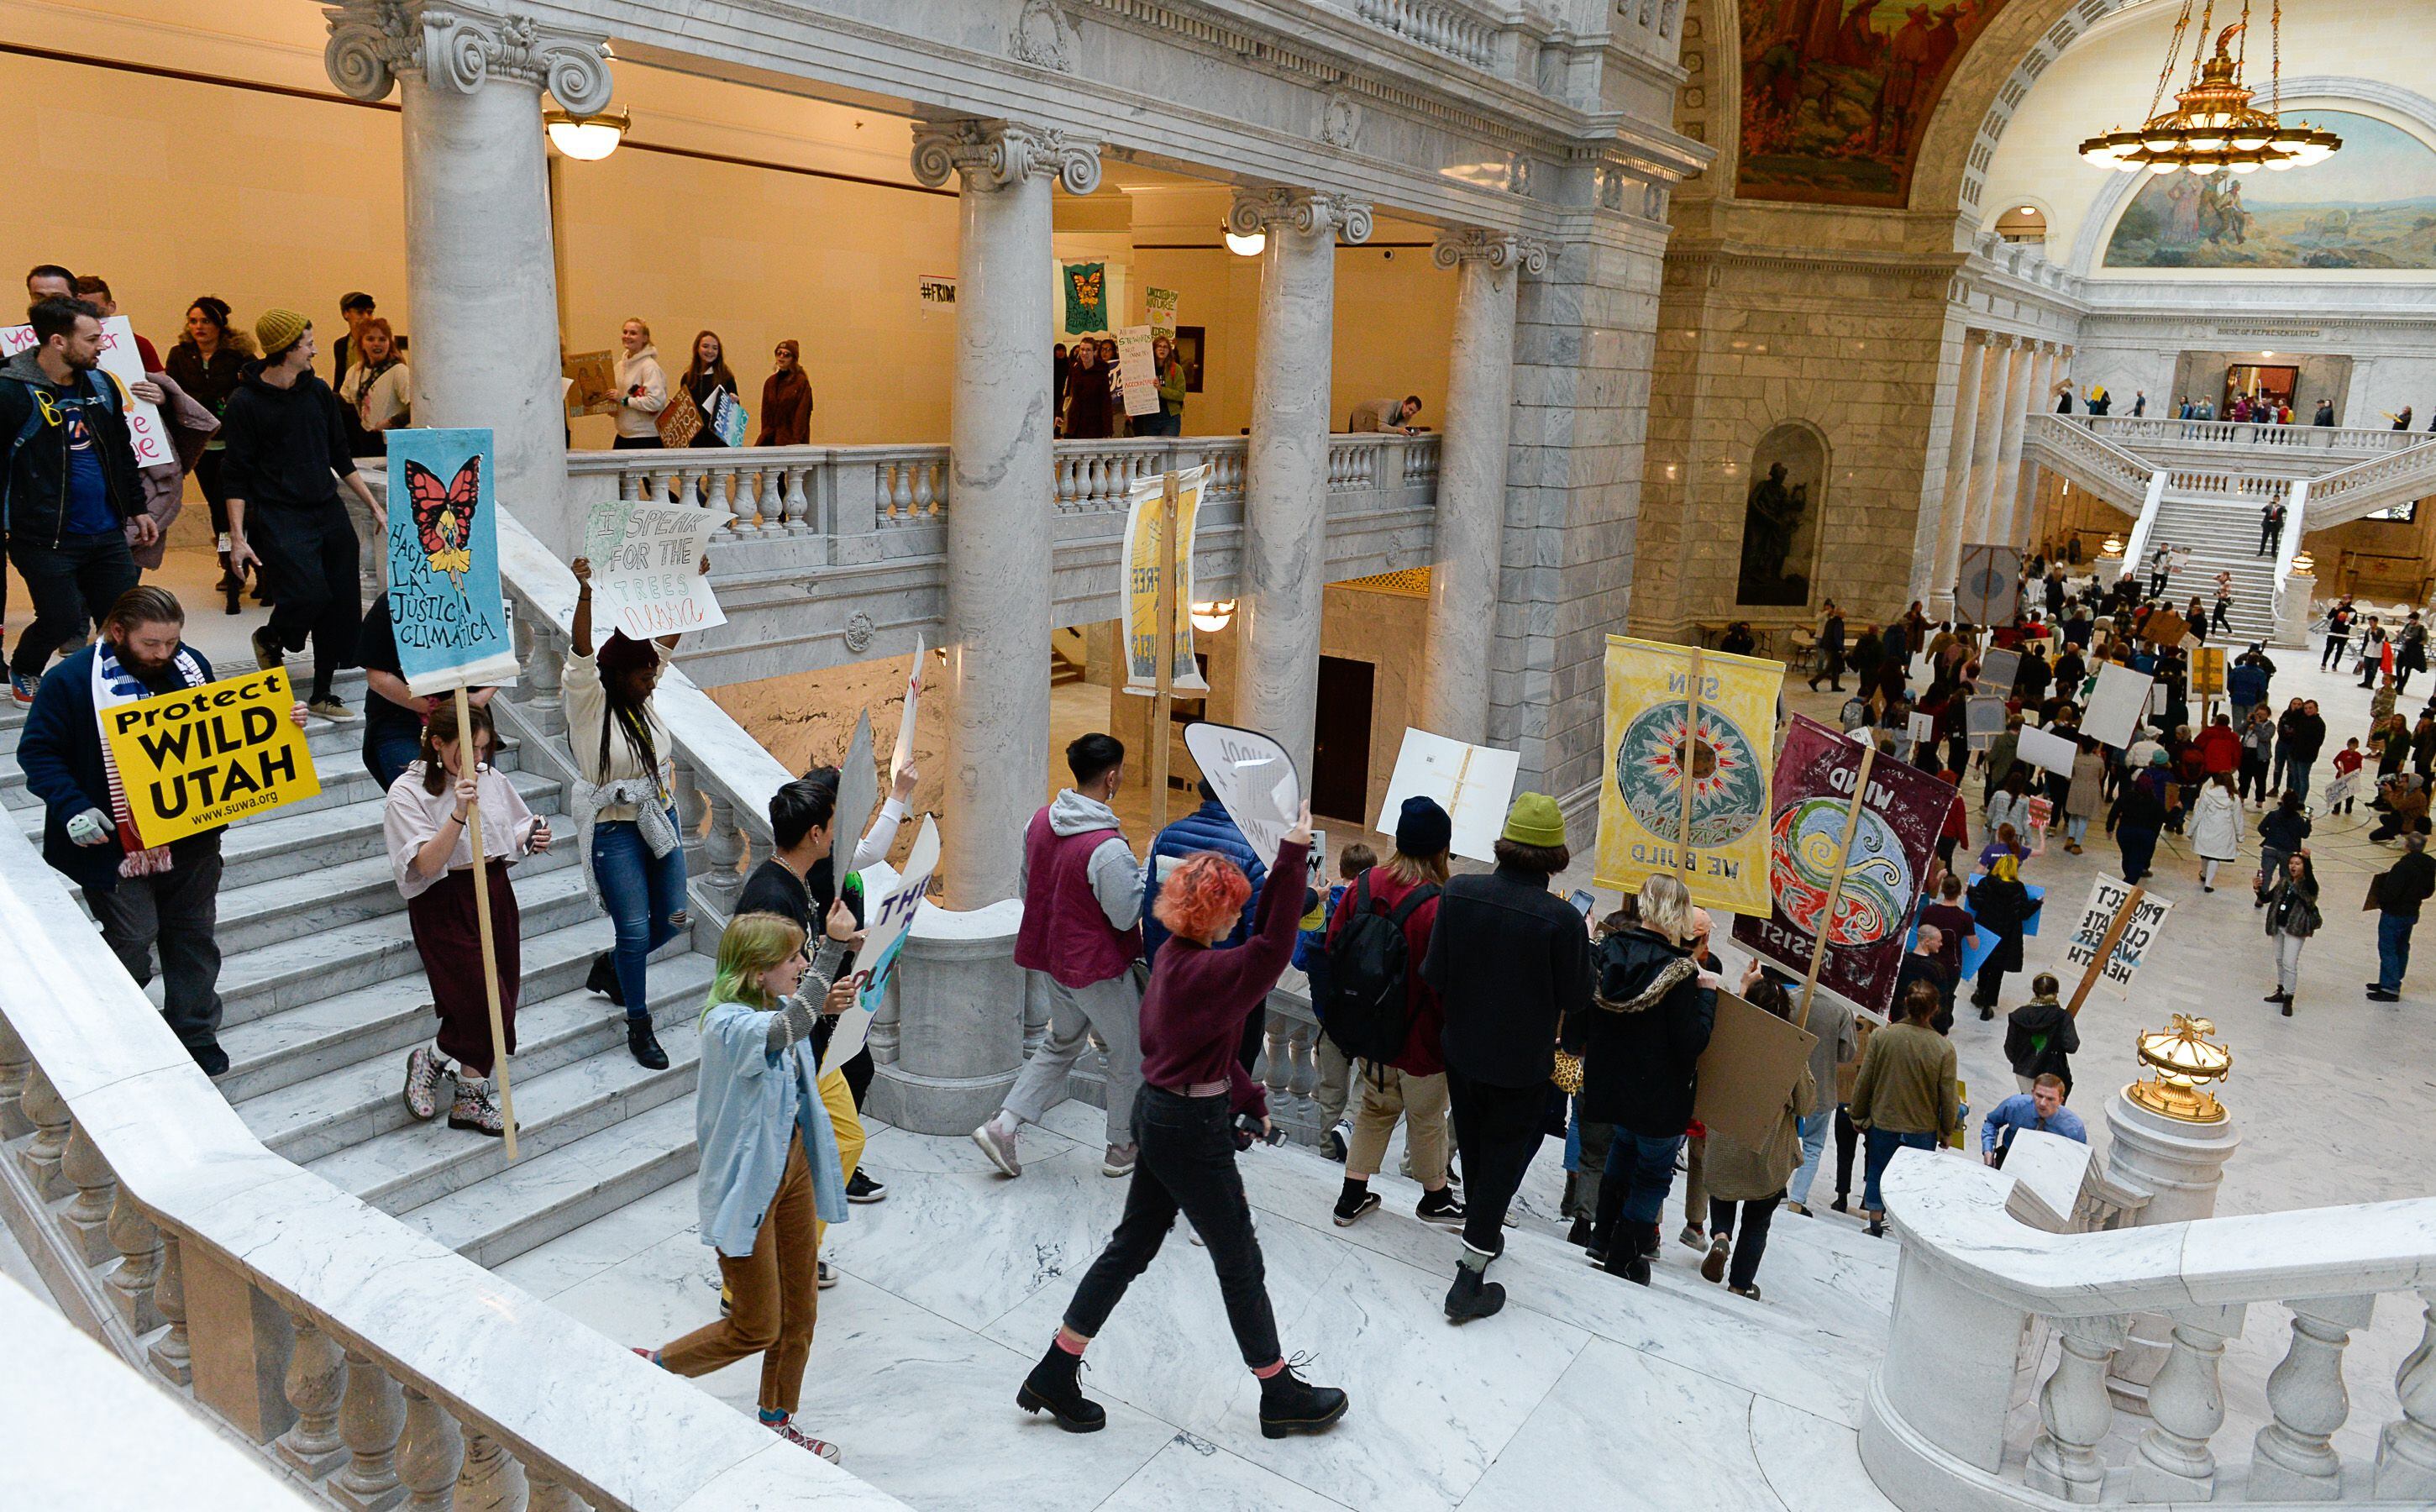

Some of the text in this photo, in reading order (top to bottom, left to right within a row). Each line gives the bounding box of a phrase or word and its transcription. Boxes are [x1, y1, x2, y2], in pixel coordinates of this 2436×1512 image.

[2217, 328, 2239, 336] HOUSE
[2250, 328, 2320, 337] REPRESENTATIVES
[597, 508, 711, 538] I SPEAK
[610, 537, 694, 572] FOR THE
[391, 560, 427, 596] LA
[613, 573, 690, 602] TREES
[115, 675, 281, 735] Protect
[137, 706, 278, 773] WILD
[149, 743, 297, 820] UTAH
[192, 791, 279, 826] www.suwa.org
